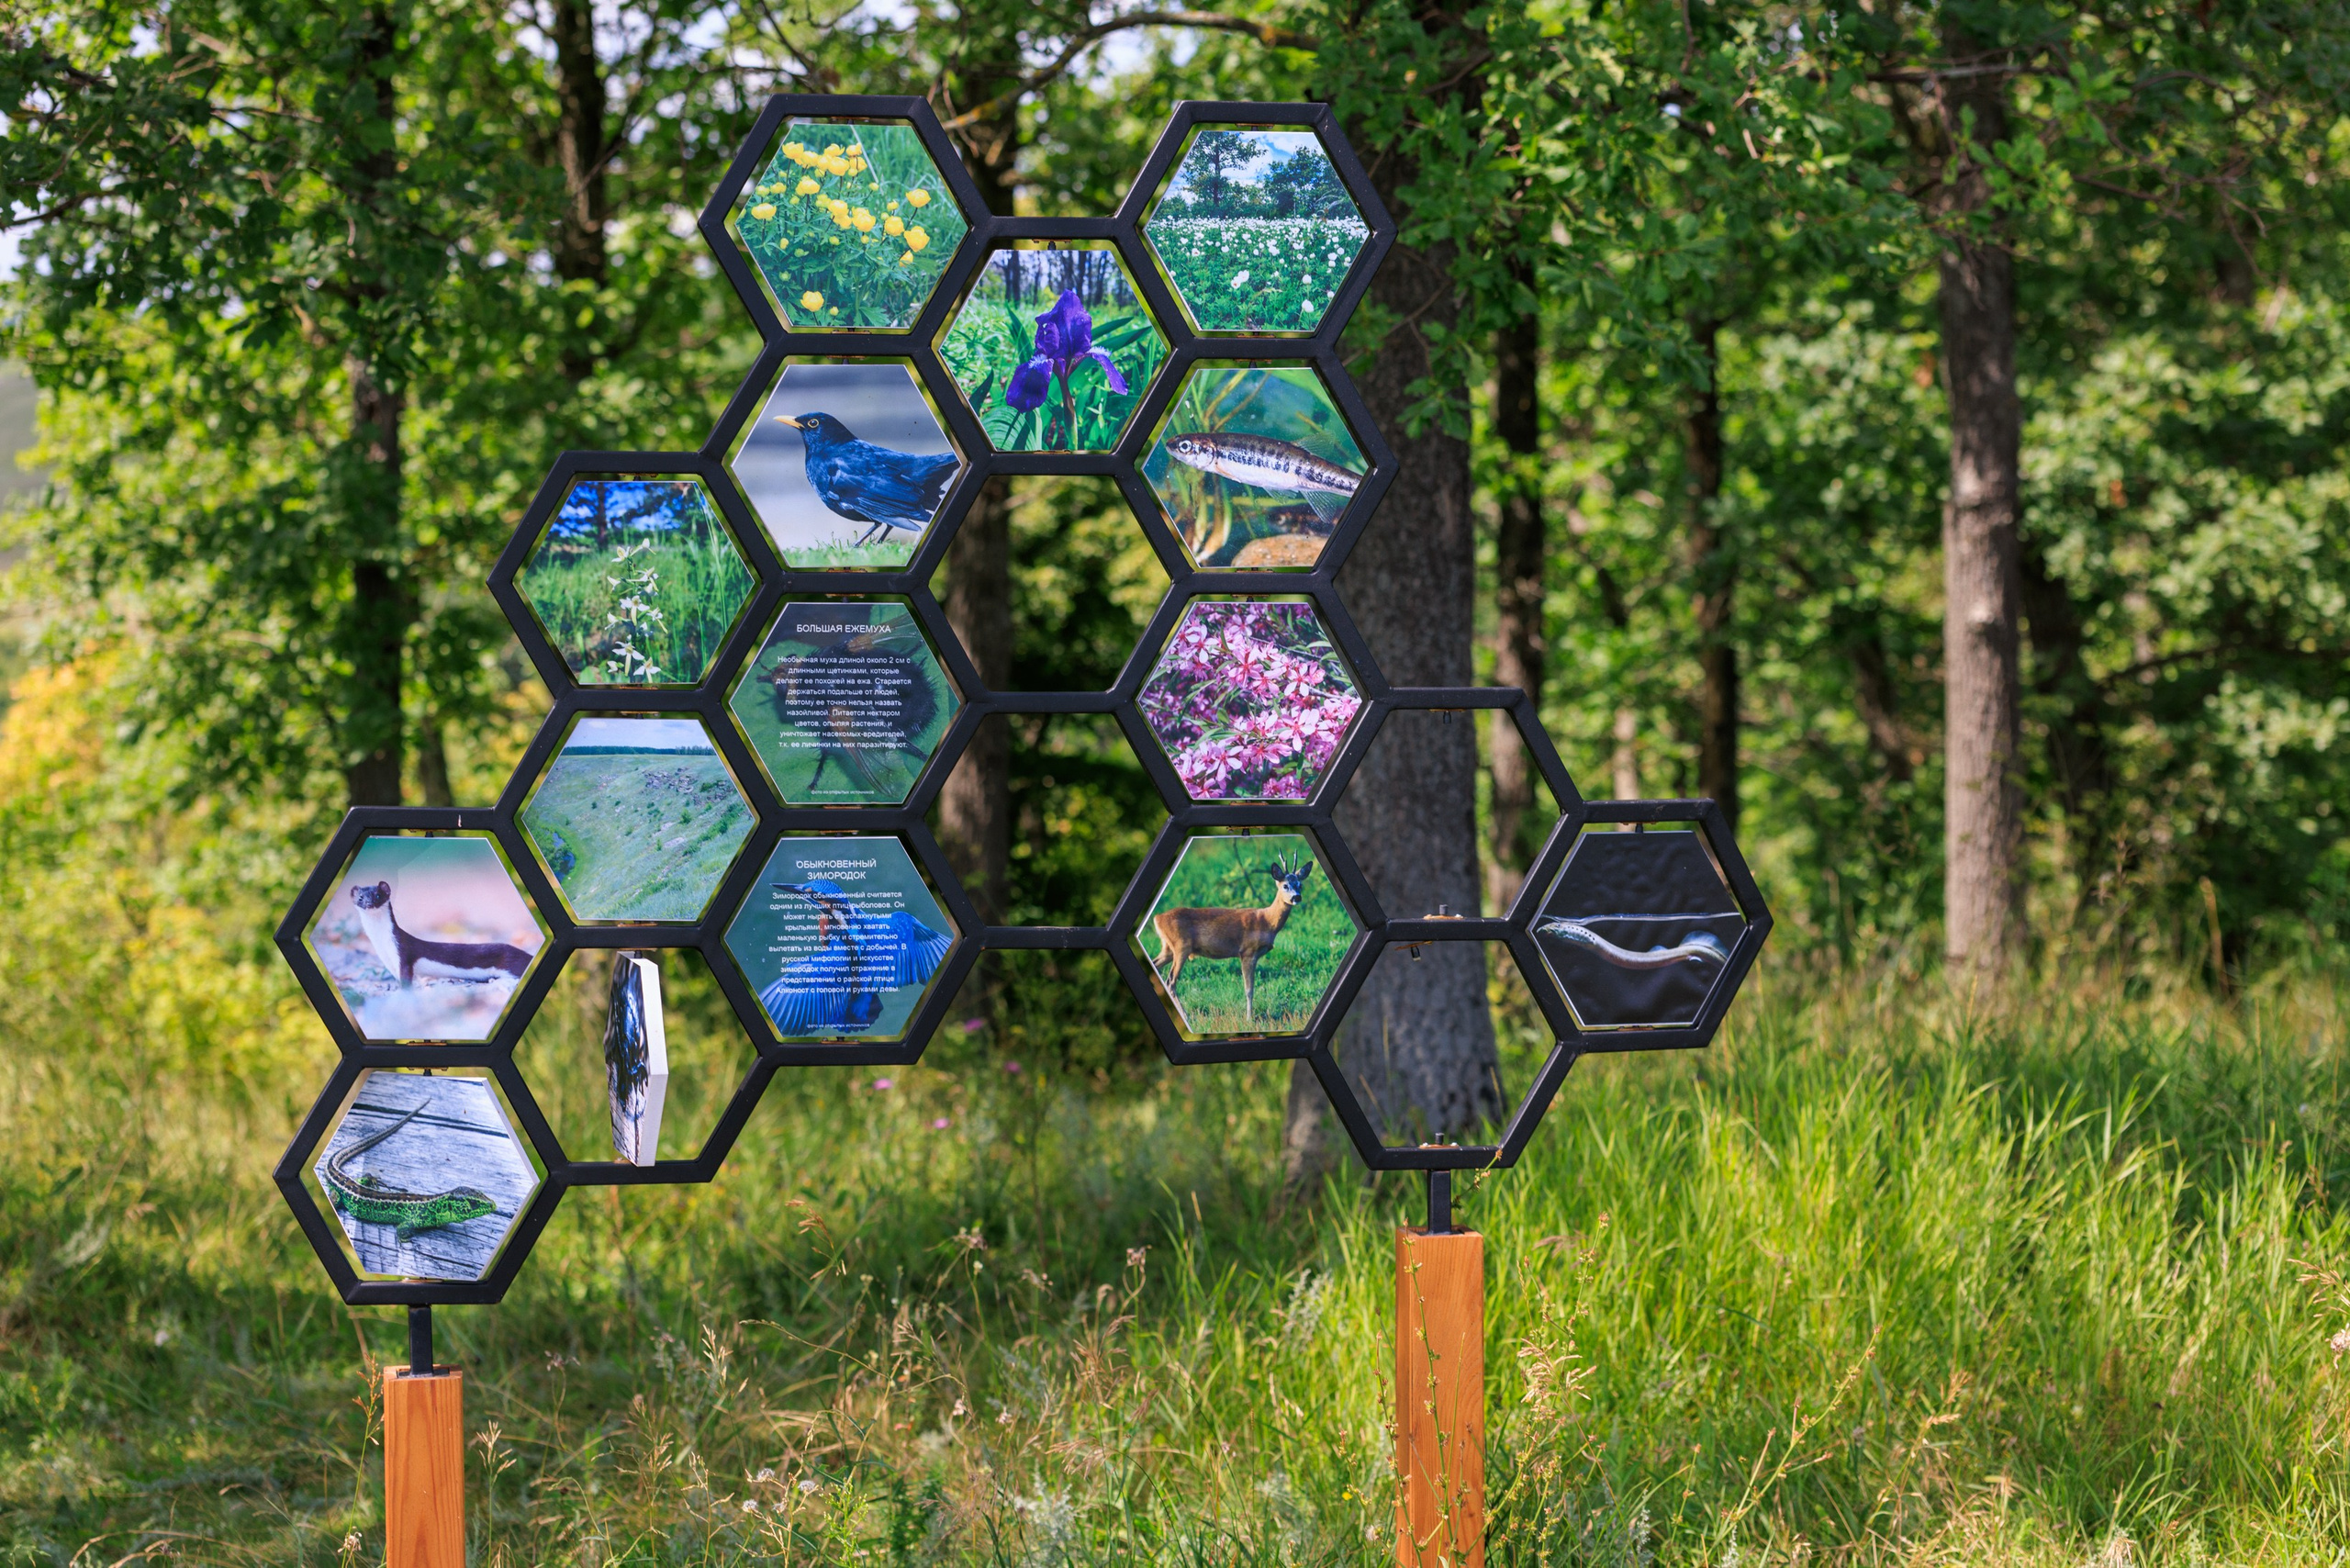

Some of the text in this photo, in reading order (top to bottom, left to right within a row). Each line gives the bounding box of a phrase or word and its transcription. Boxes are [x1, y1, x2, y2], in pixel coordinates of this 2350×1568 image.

[796, 624, 891, 633] БОЛЬШАЯ ЕЖЕМУХА
[838, 656, 865, 664] длиной
[874, 677, 912, 685] Старается
[796, 858, 876, 869] ОБЫКНОВЕННЫЙ
[807, 871, 866, 881] ЗИМОРОДОК
[819, 934, 840, 942] рыбку
[811, 955, 852, 963] мифологии
